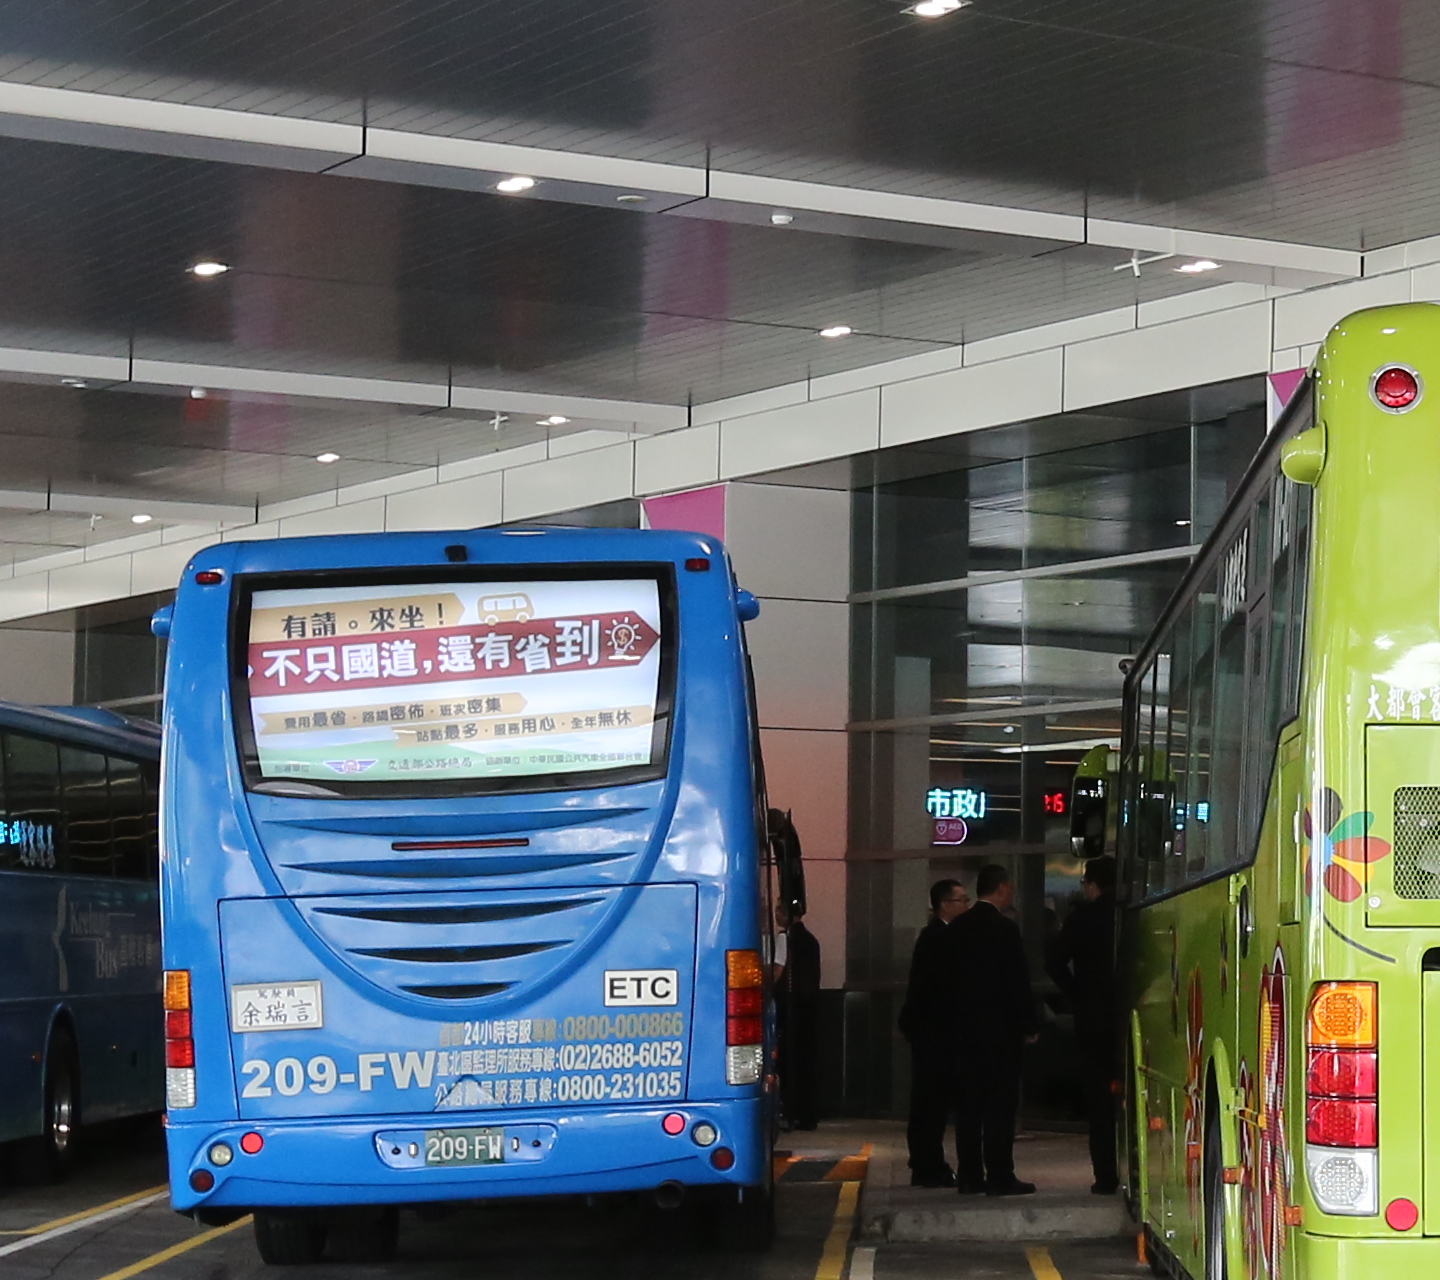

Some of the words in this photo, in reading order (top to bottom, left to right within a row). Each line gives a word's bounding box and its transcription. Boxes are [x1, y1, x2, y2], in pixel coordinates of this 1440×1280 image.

[608, 976, 671, 1000] ETC
[241, 999, 313, 1027] 余瑞言
[241, 1051, 436, 1098] 209-FW
